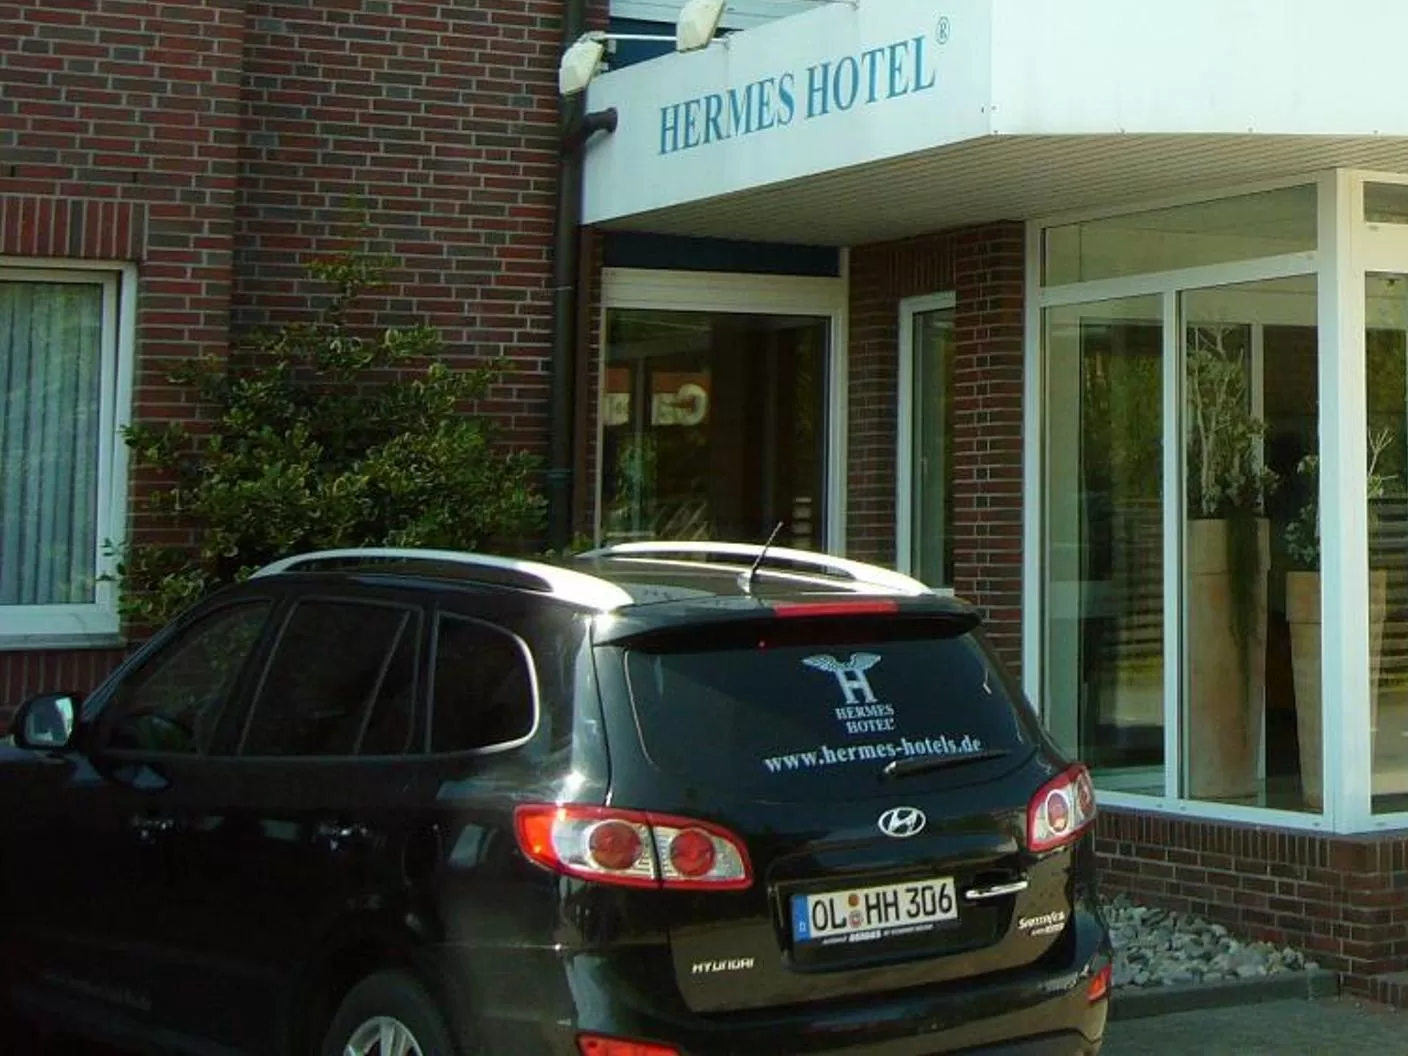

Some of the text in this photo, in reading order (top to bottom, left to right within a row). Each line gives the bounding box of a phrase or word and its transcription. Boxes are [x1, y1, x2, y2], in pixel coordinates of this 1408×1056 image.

[658, 72, 796, 155] HERMES
[834, 702, 896, 721] HERMES
[763, 734, 983, 774] www.hermes-hotels.de
[811, 897, 848, 933] OL
[863, 889, 901, 925] HH
[905, 882, 954, 919] 306
[691, 956, 756, 974] HYUNDAI
